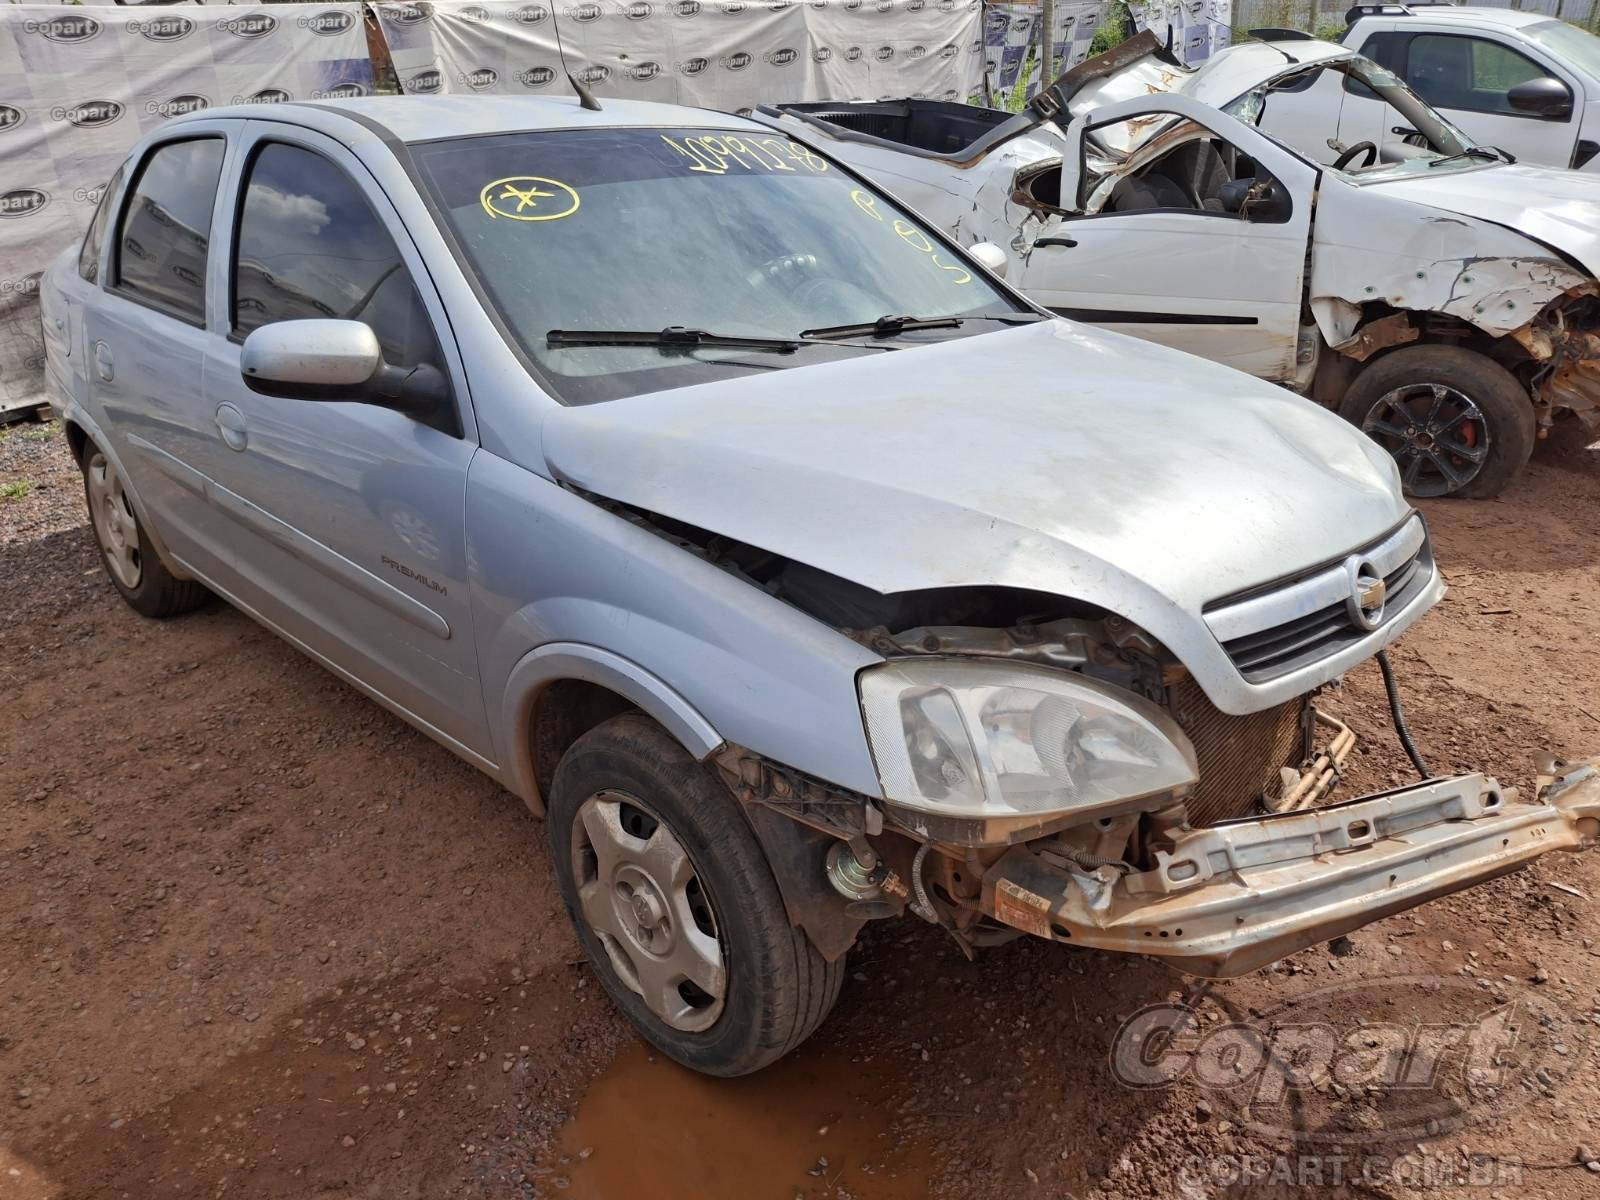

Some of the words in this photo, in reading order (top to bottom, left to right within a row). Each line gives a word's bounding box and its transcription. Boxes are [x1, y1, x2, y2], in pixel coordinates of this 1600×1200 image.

[381, 6, 425, 20] Copar
[505, 7, 547, 21] Copart
[563, 5, 600, 19] Copart
[616, 3, 652, 18] Copart
[23, 19, 95, 37] Copart
[126, 19, 190, 36] Copart
[216, 17, 273, 32] Copart
[297, 15, 348, 31] Copart
[458, 71, 495, 86] Copart
[513, 69, 551, 85] Copart
[51, 103, 119, 122] Copart
[145, 97, 206, 116] Copart
[380, 555, 448, 597] PREMIUM
